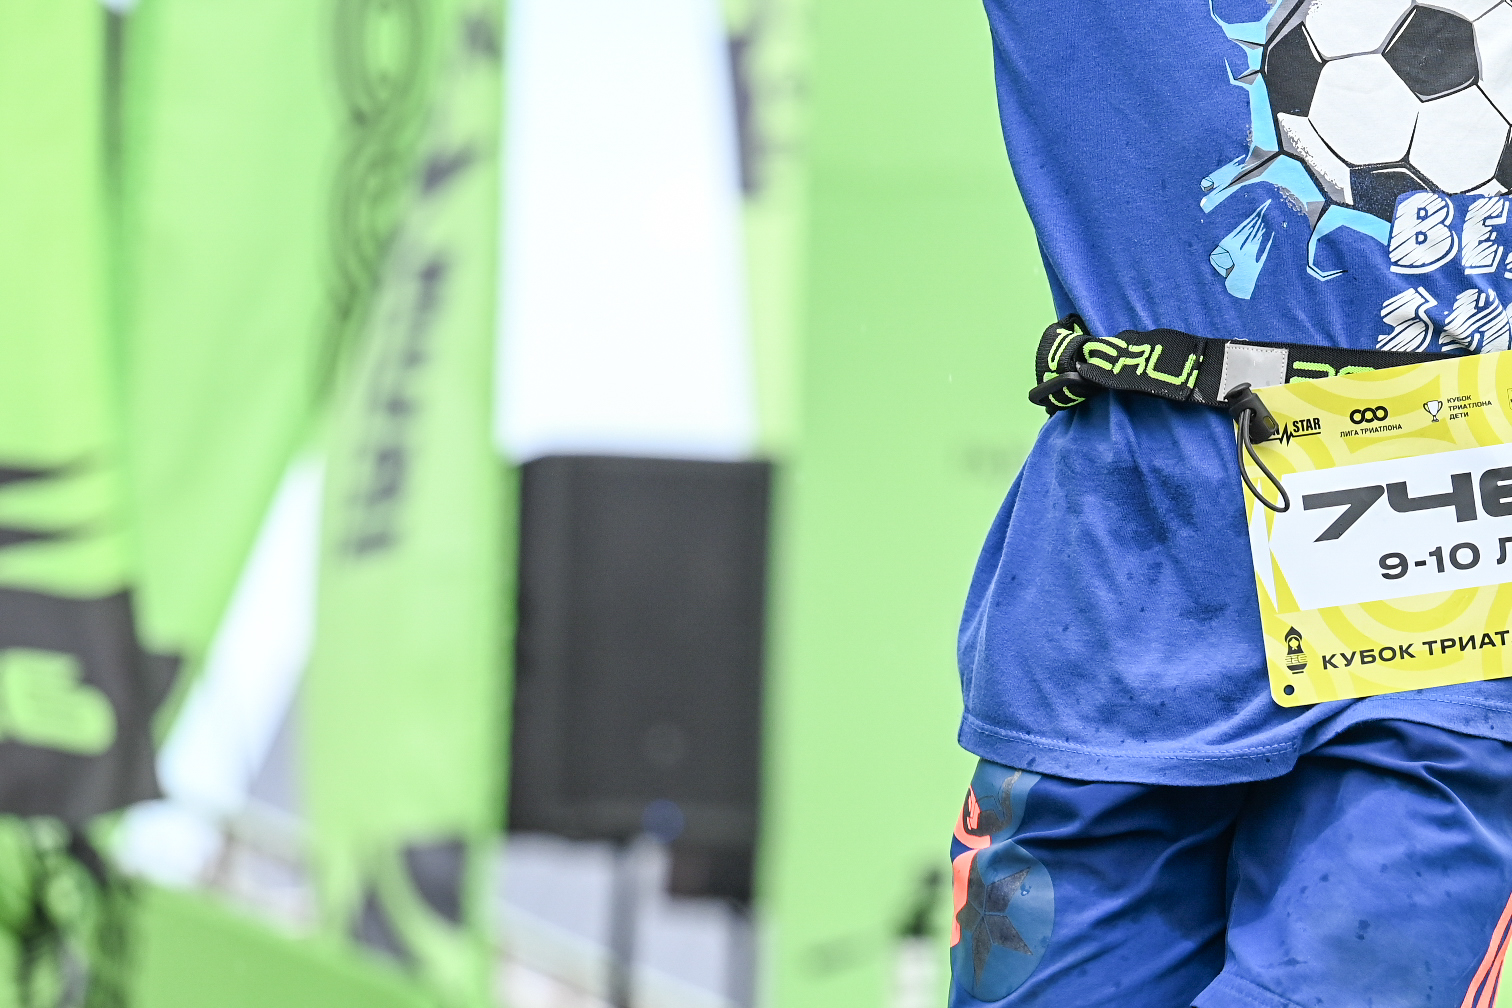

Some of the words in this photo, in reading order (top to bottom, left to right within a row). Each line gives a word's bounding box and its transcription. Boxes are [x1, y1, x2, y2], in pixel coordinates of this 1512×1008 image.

[1446, 394, 1472, 404] КУБОК
[1448, 400, 1493, 412] ТРИАТЛОНА
[1449, 411, 1470, 421] ДЕТИ
[1340, 429, 1360, 438] ЛИГА
[1360, 423, 1403, 435] ТРИАТЛОНА
[1378, 541, 1481, 580] 9-10
[1322, 643, 1417, 671] КУБОК
